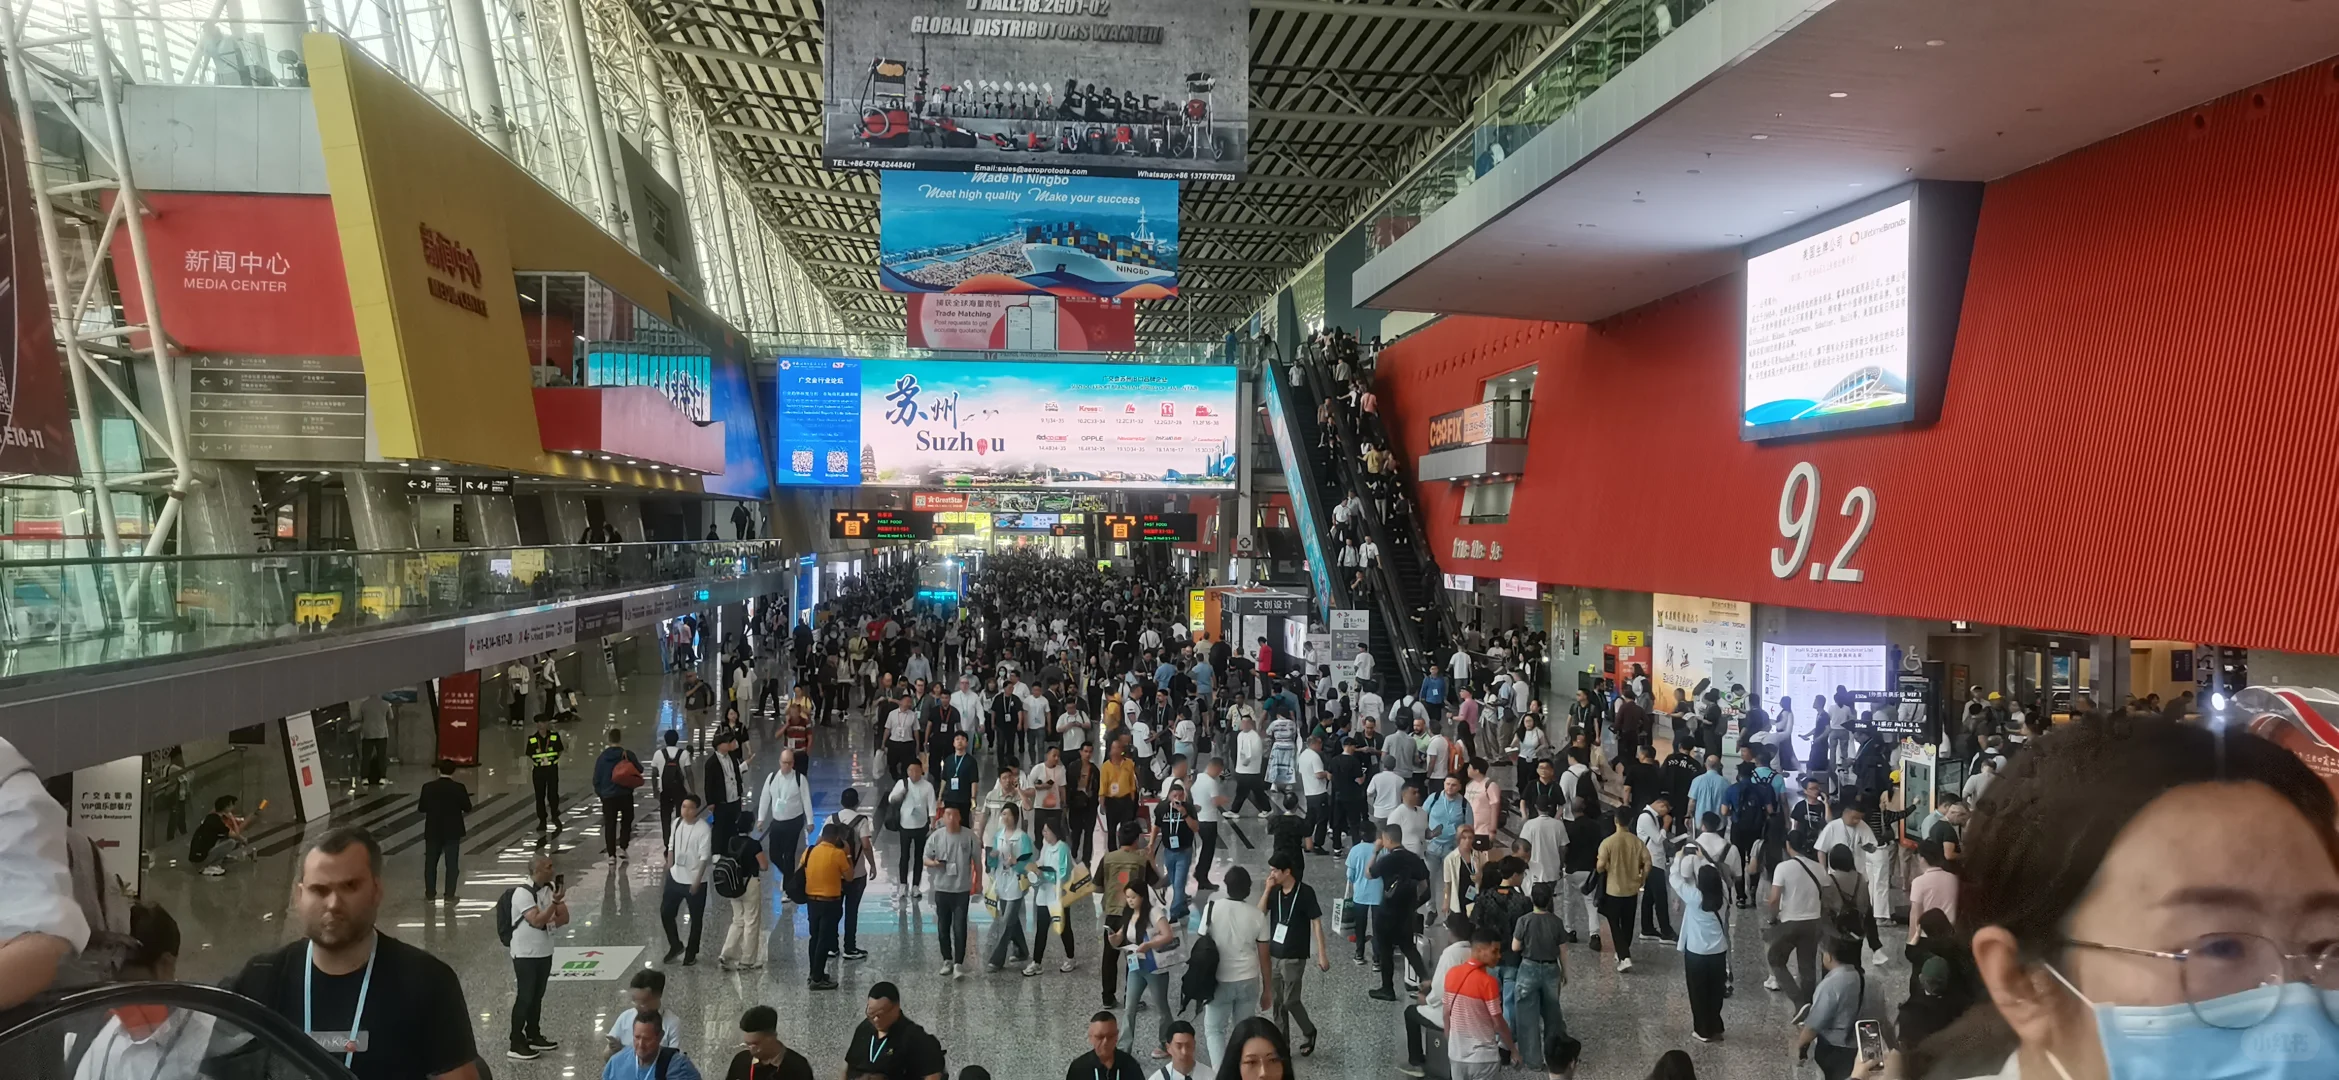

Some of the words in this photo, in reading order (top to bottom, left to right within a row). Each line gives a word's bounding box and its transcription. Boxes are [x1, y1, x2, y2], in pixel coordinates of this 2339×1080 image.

[910, 15, 970, 35] GLOBAL
[972, 18, 1090, 41] DISTRIBUTORS
[1092, 23, 1165, 45] WANTED!
[974, 164, 1088, 176] Email:sales@aeroprotools.com
[1137, 170, 1189, 180] Whatsapp:+86
[962, 172, 1009, 185] Made
[1011, 174, 1023, 184] In
[1026, 175, 1070, 188] Ningbo
[918, 184, 957, 199] Meet
[958, 189, 982, 201] high
[985, 190, 1022, 203] quality
[1027, 187, 1068, 202] Make
[1070, 195, 1095, 206] your
[1097, 195, 1141, 205] success
[184, 248, 290, 275] 新闻中心
[1116, 265, 1150, 276] NINGBO
[184, 277, 228, 290] MEDIA
[231, 279, 287, 292] CENTER
[222, 377, 234, 386] 3F
[884, 373, 959, 430] 苏州
[420, 480, 432, 489] 3F
[477, 481, 489, 490] 4F
[934, 496, 963, 504] GreatStar
[1771, 461, 1877, 583] 9.2
[1253, 599, 1293, 609] 大创设计
